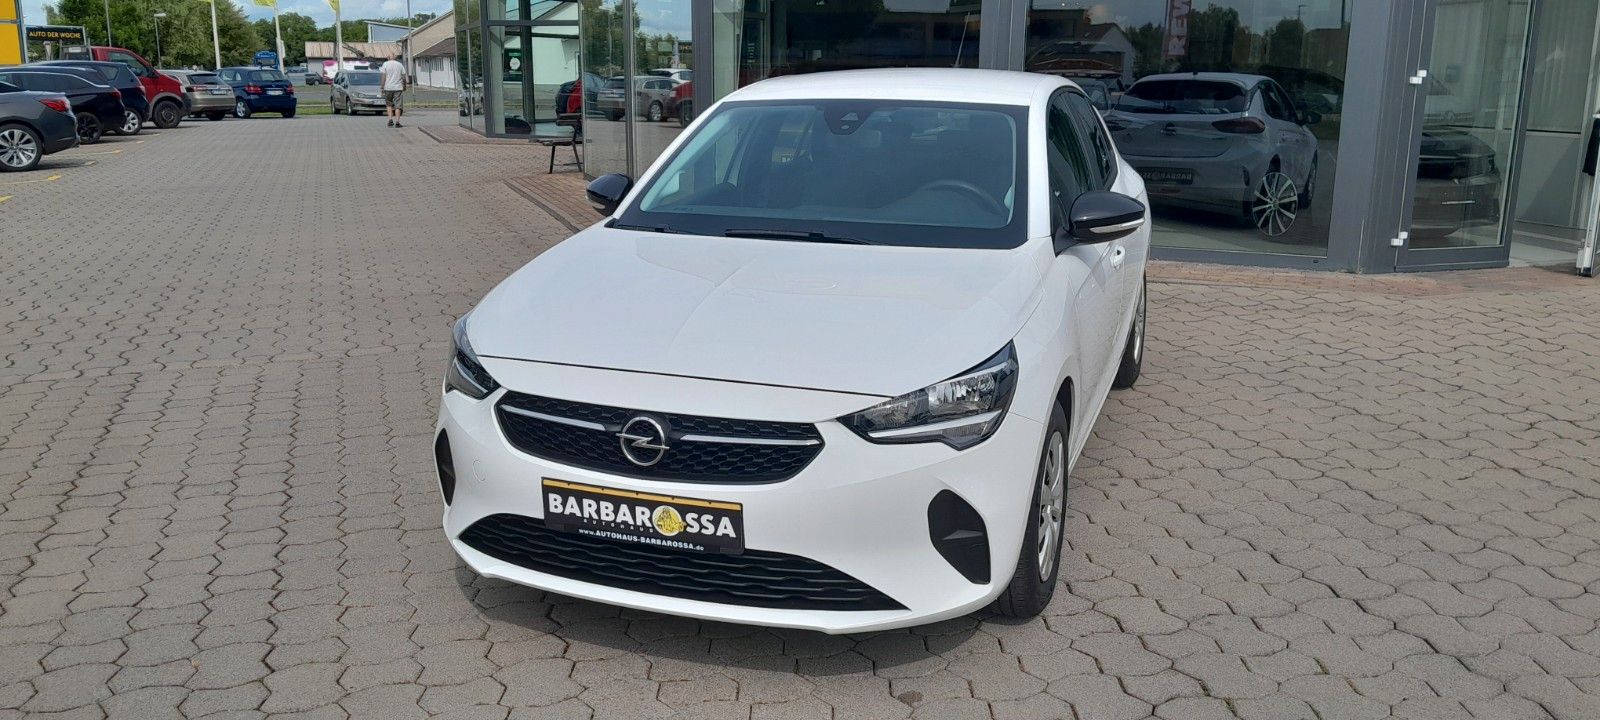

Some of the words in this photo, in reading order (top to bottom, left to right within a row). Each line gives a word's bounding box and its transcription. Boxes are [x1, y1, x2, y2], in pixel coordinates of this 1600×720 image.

[548, 493, 736, 538] BARBAROSSA
[584, 519, 654, 533] AUTOHAUS
[578, 528, 705, 551] www.AUTOHAUS-BARBAROSSA.de
